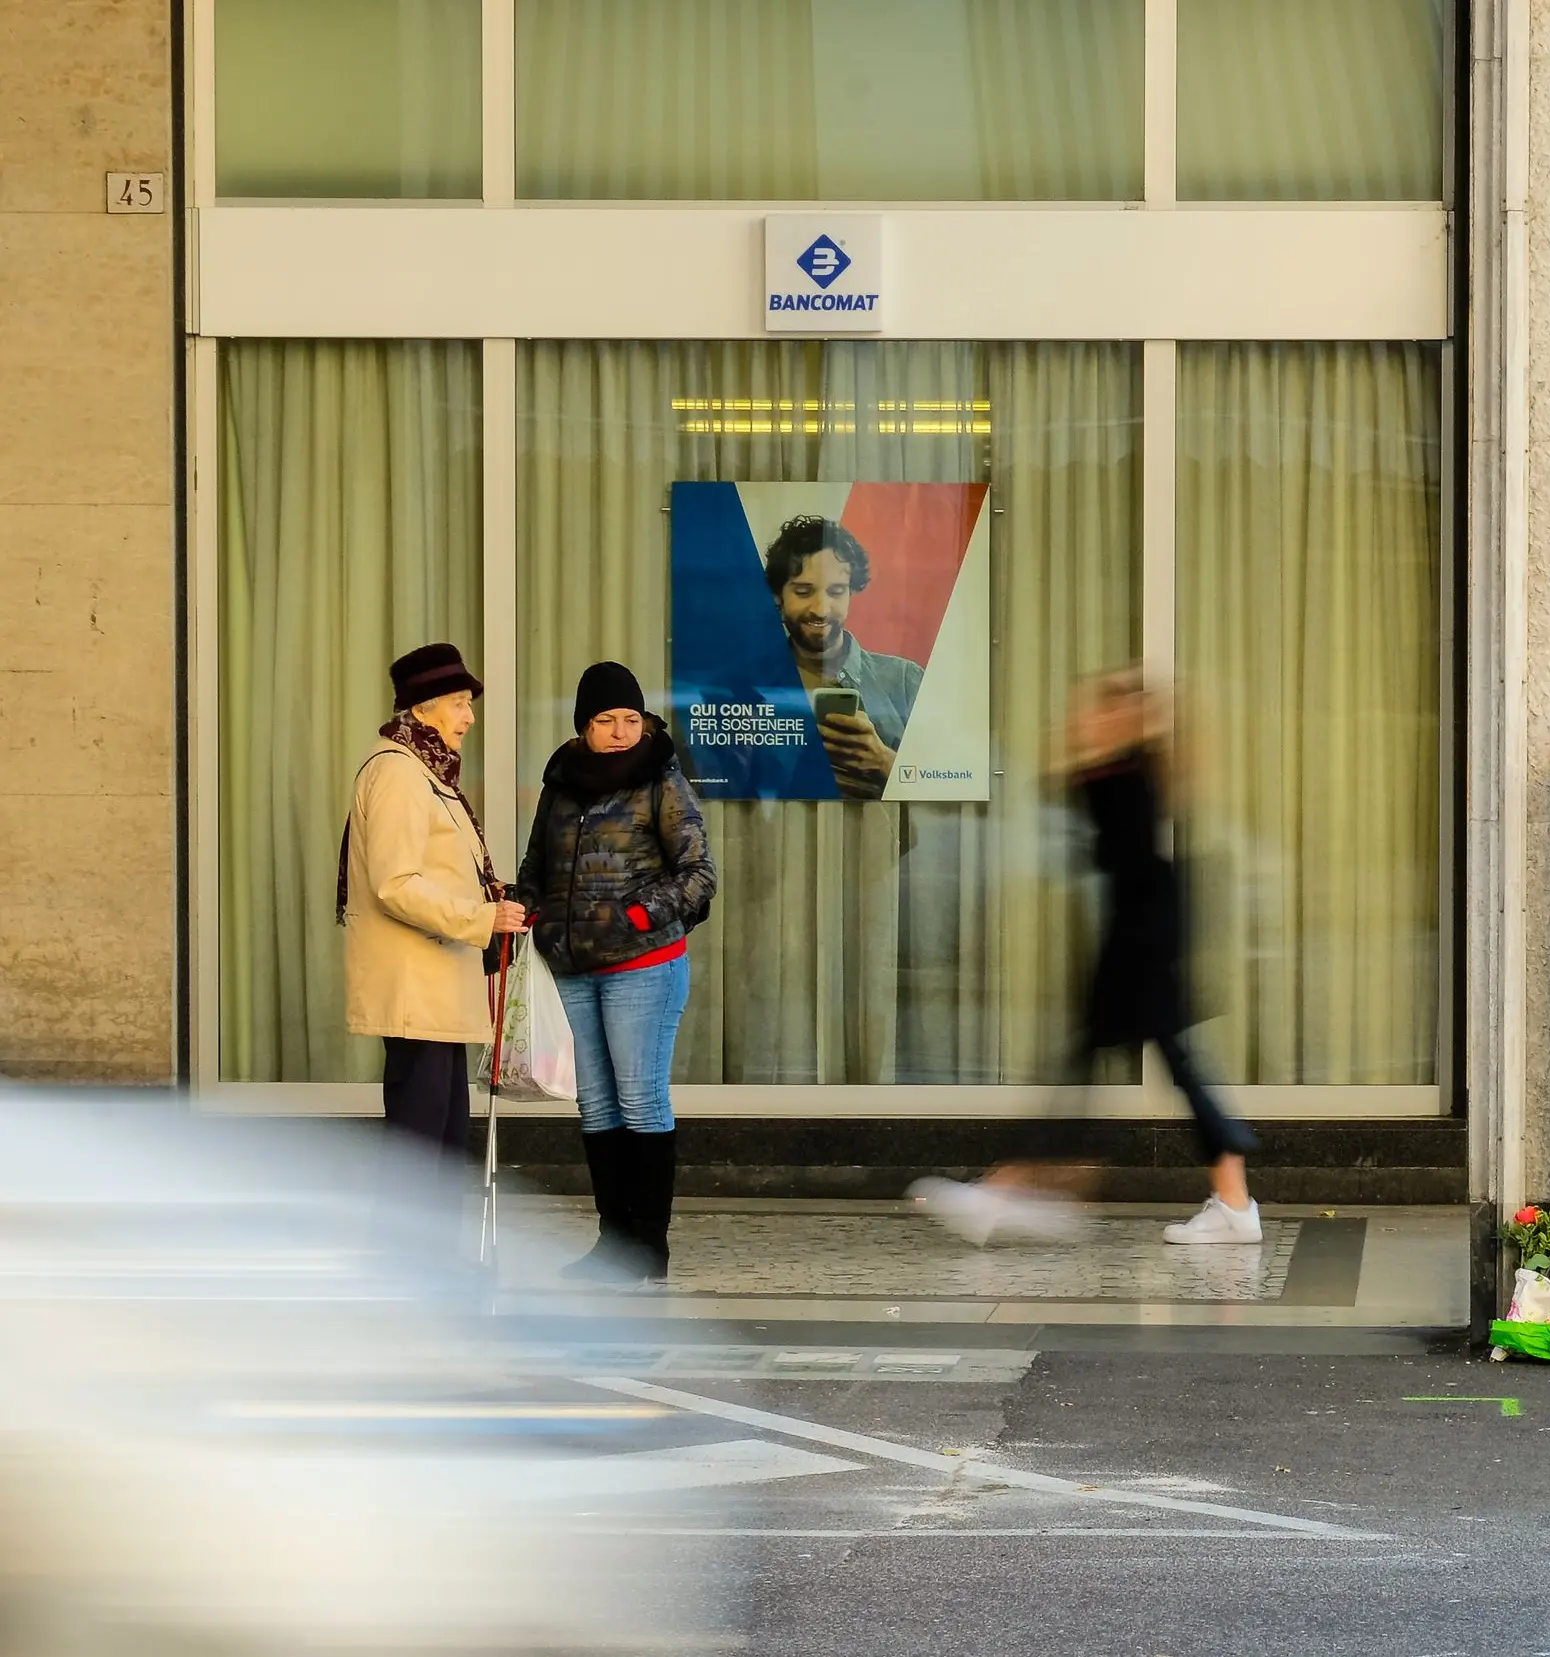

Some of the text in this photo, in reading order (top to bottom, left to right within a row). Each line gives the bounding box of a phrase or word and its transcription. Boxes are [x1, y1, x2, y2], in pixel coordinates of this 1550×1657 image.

[119, 179, 153, 207] 45
[768, 294, 880, 311] BANCOMAT
[689, 703, 775, 717] QUI CON TE
[690, 718, 805, 732] PER SOSTENERE
[690, 733, 808, 747] I TUOI PROGETTI.
[919, 769, 973, 780] Volksbank
